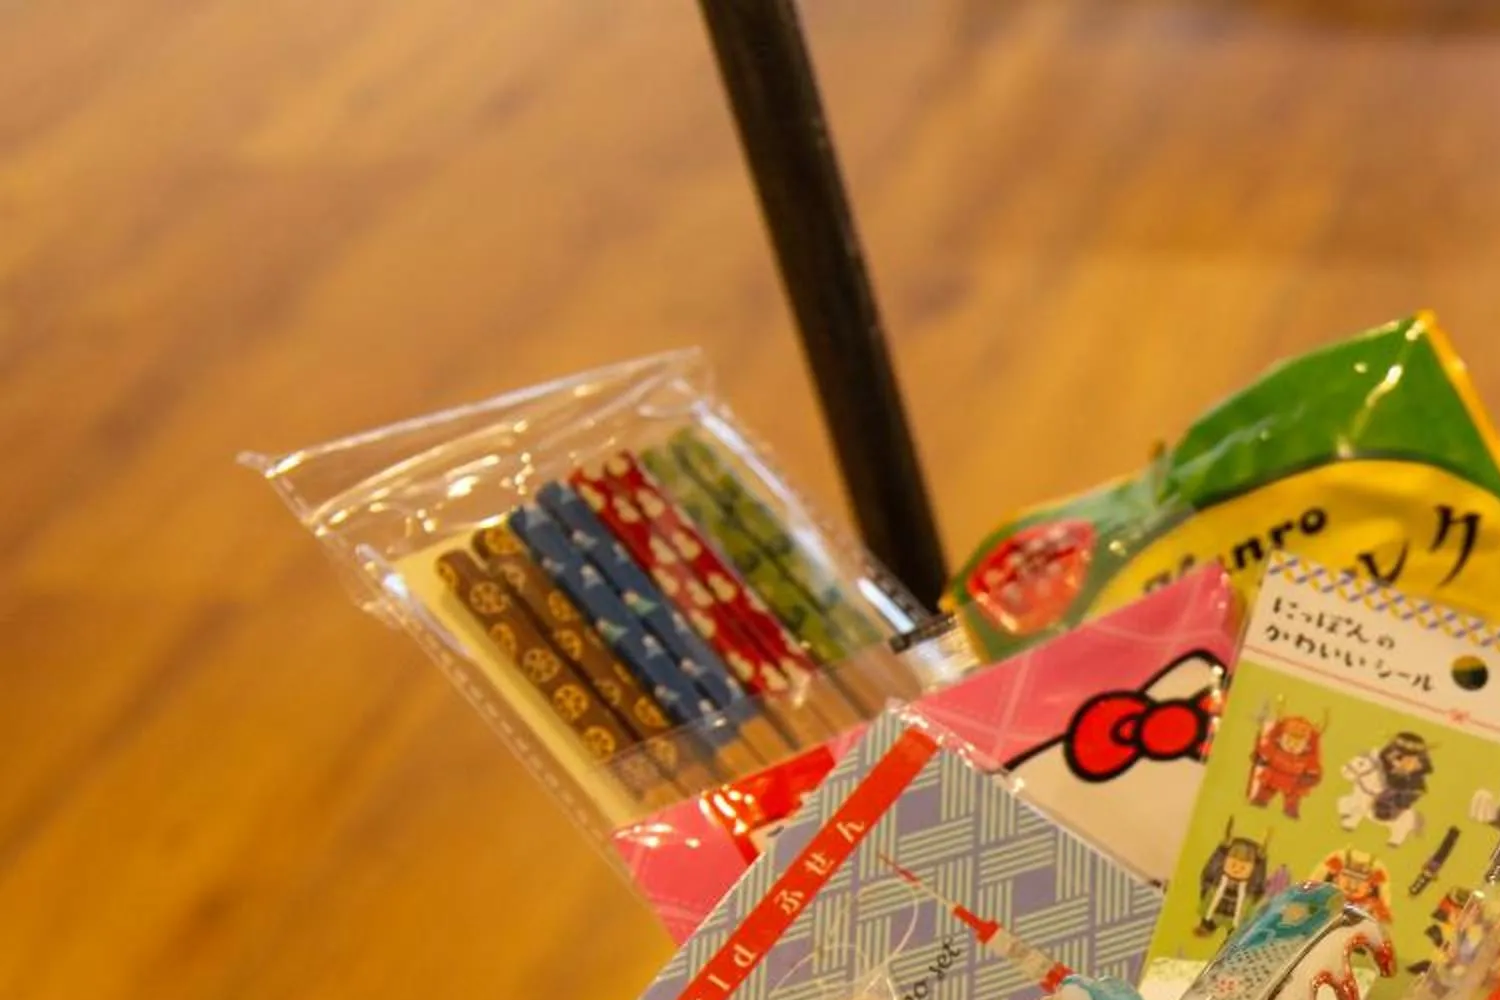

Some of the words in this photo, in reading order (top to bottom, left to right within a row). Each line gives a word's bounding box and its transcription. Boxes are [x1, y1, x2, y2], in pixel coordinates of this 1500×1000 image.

[1263, 623, 1435, 693] かわいいシール
[1272, 598, 1396, 650] にっぽんの
[774, 818, 865, 916] ふせん
